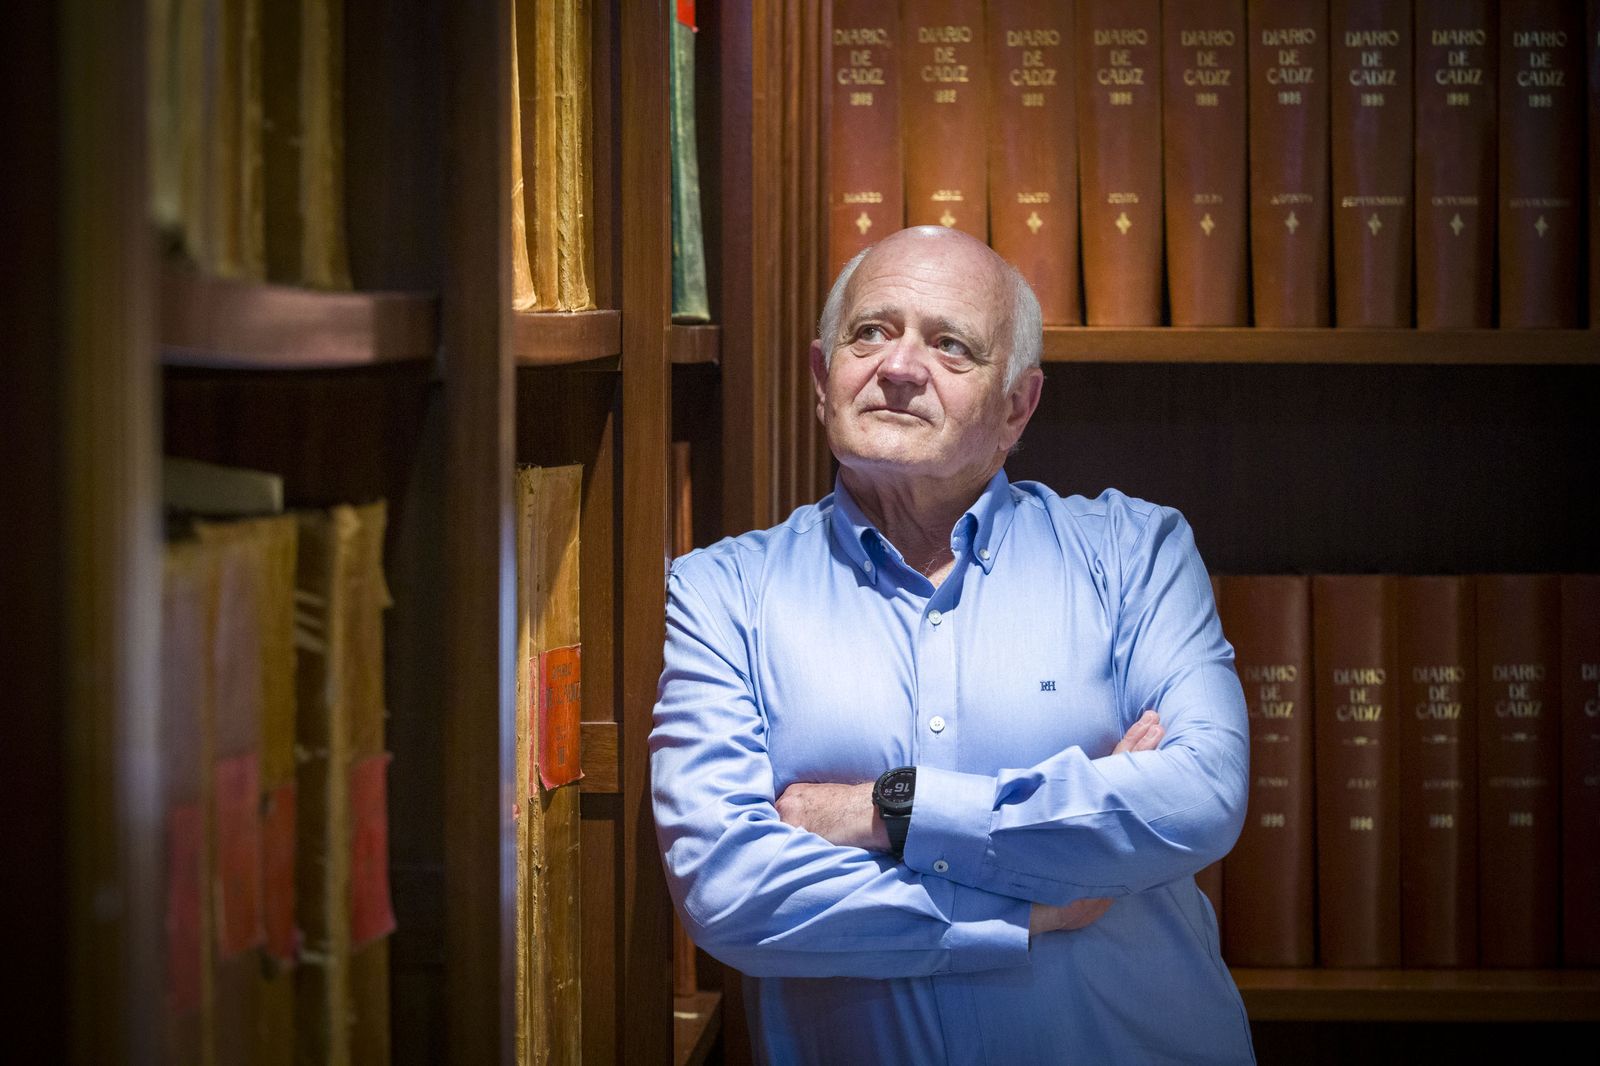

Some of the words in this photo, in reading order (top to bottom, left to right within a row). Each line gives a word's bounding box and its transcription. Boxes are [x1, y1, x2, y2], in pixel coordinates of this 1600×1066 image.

[835, 28, 887, 44] DIARIO
[918, 25, 972, 43] DIARIO
[1006, 29, 1060, 47] DIARIO
[1093, 28, 1148, 46] DIARIO
[1180, 29, 1235, 47] DIARIO
[1261, 28, 1317, 46] DIARIO
[1344, 30, 1400, 47] DIARIO
[1431, 29, 1486, 46] DIARIO
[1513, 31, 1566, 47] DIARIO
[850, 49, 873, 67] DE
[934, 46, 957, 64] DE
[1022, 50, 1045, 67] DE
[1109, 49, 1133, 67] DE
[1196, 51, 1219, 67] DE
[1278, 49, 1300, 66] DE
[1361, 51, 1382, 67] DE
[1447, 50, 1470, 66] DE
[1528, 52, 1552, 68] DE
[1260, 684, 1281, 700] DE
[1350, 688, 1370, 704] DE
[1429, 684, 1451, 700] DE
[1509, 683, 1530, 699] DE
